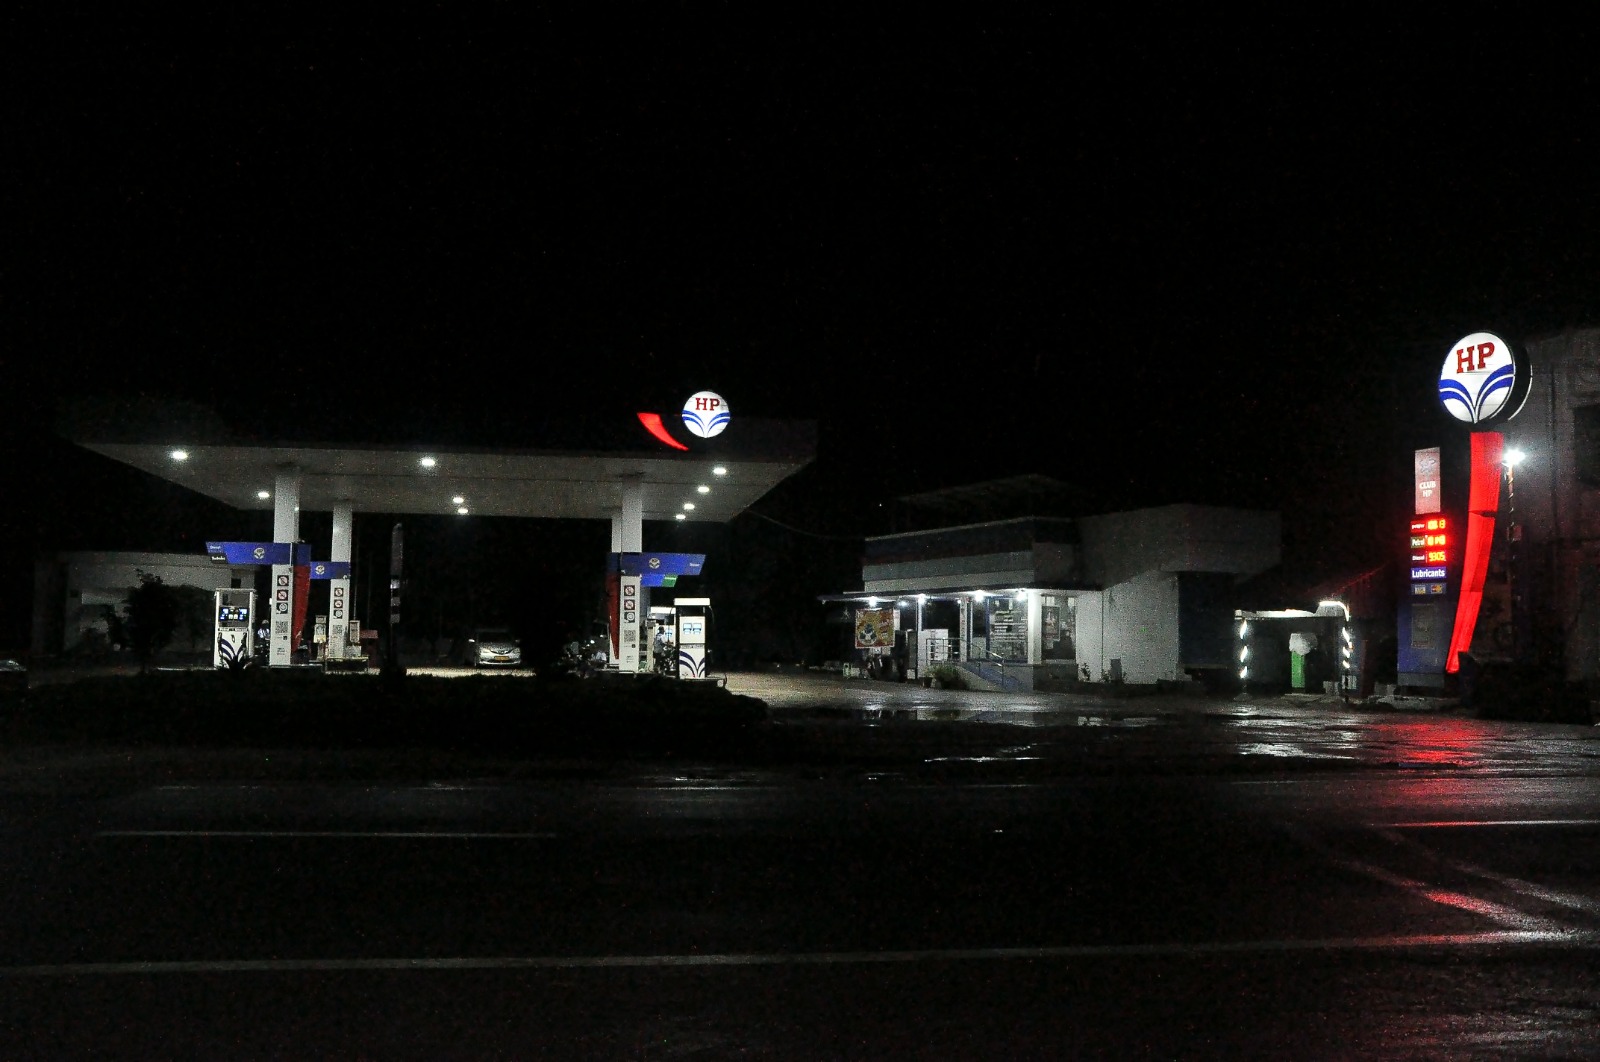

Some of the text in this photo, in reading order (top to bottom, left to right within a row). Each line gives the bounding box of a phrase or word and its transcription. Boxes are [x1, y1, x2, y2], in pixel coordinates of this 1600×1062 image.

[1456, 342, 1495, 374] HP
[695, 397, 720, 411] HP
[1419, 481, 1436, 489] CLUB
[1412, 569, 1445, 578] Lubricants
